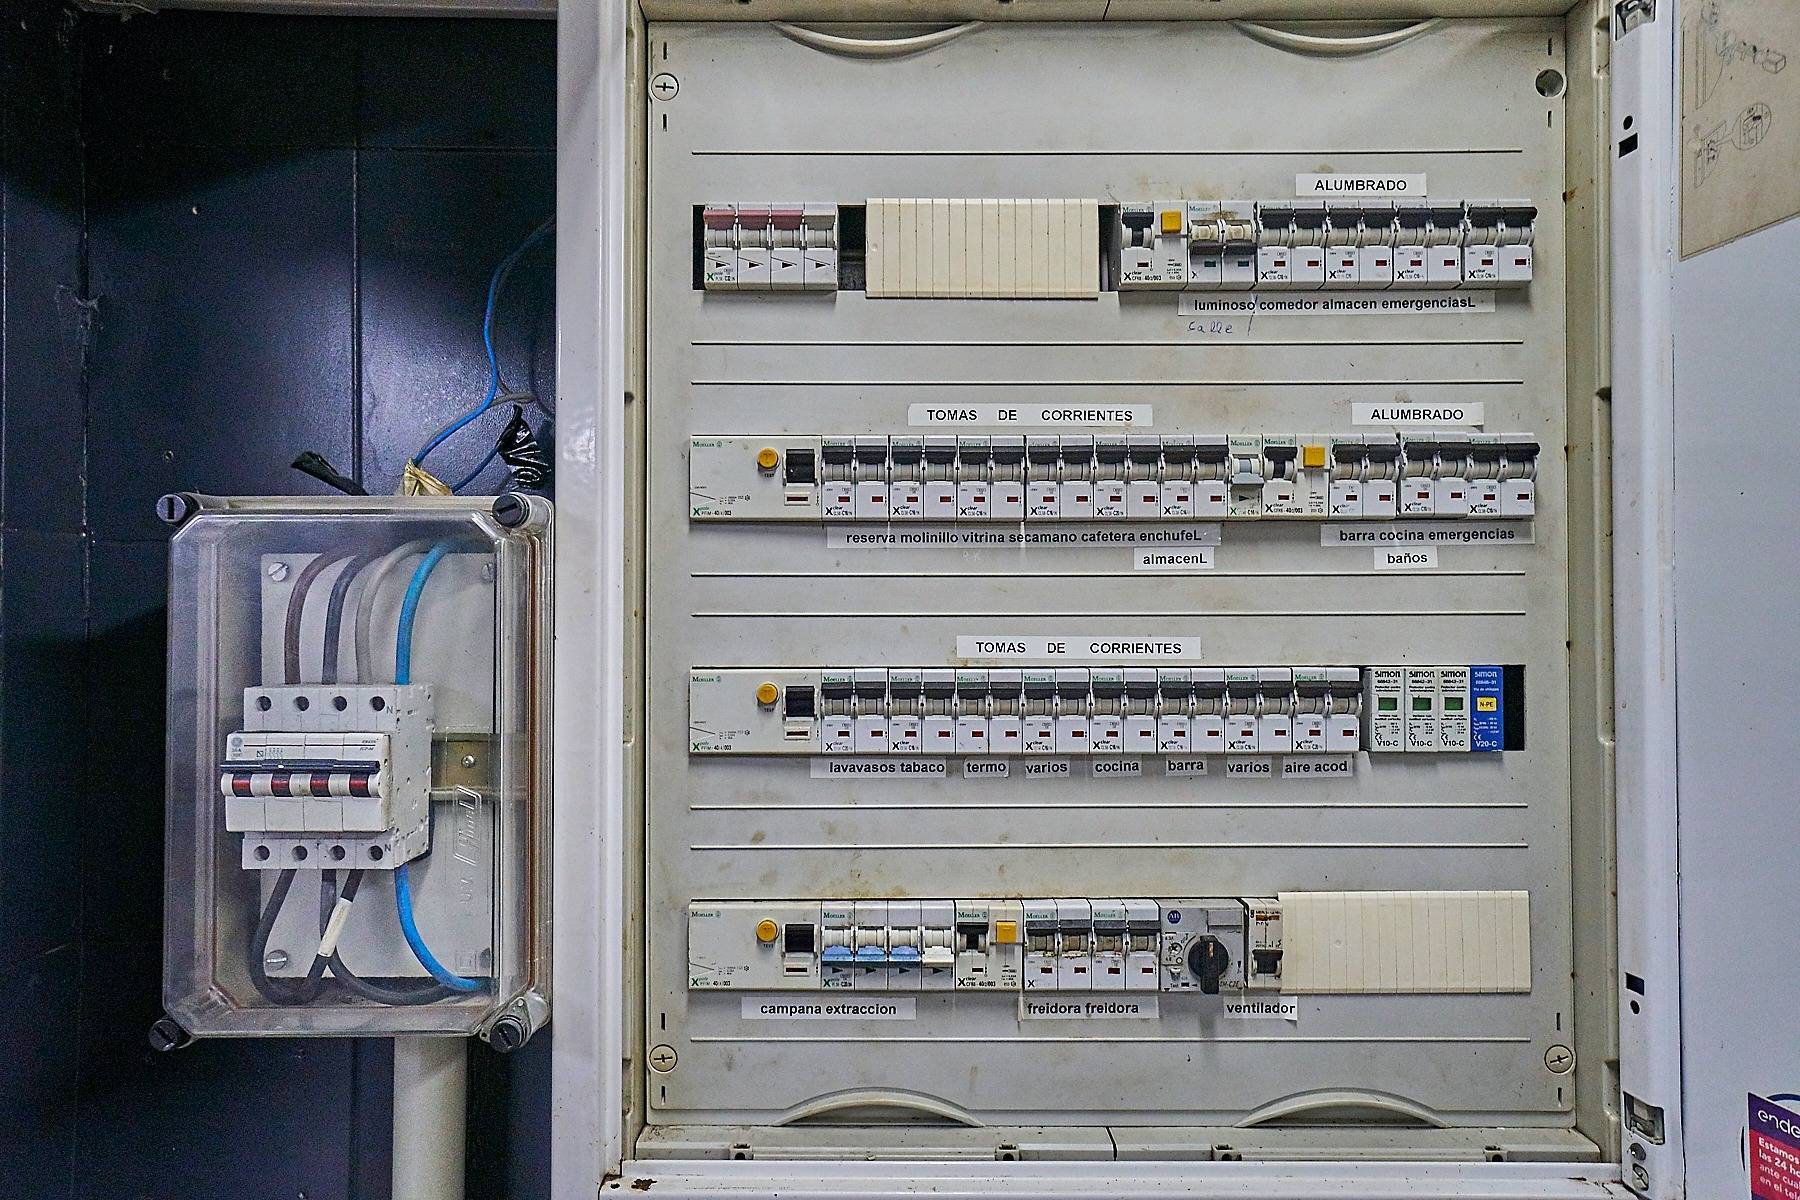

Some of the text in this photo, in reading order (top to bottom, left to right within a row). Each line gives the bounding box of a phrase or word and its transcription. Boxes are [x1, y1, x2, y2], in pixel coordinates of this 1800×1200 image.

[1314, 179, 1407, 191] ALUMBRADO
[1194, 297, 1476, 313] luminoso comedor almacen emergenciasL
[926, 409, 1133, 422] TOMAS DE CORRIENTES
[1370, 408, 1464, 420] ALUMBRADO
[846, 530, 1202, 543] reserva molinillo vitrina secamano cafetera enchufeL
[1339, 528, 1515, 543] barra cocina emergencias
[1143, 552, 1208, 565] almacenL
[1387, 552, 1428, 564] baños
[975, 641, 1182, 654] TOMAS DE CORRIENTES
[829, 760, 945, 773] lavavasos tabaco
[966, 762, 1006, 773] termo
[1025, 761, 1068, 773] varios
[1095, 760, 1139, 773] cocina
[1168, 760, 1204, 771] barra
[1227, 762, 1270, 773] varios
[1284, 761, 1348, 773] aire acod
[760, 1003, 897, 1017] campana extraccion
[1027, 1002, 1139, 1015] freidora freidora
[1226, 1002, 1296, 1014] ventilador
[1758, 1137, 1800, 1164] Estamos
[1758, 1148, 1772, 1163] las
[1774, 1158, 1787, 1170] 24
[1759, 1163, 1780, 1180] ante
[1760, 1176, 1771, 1187] en
